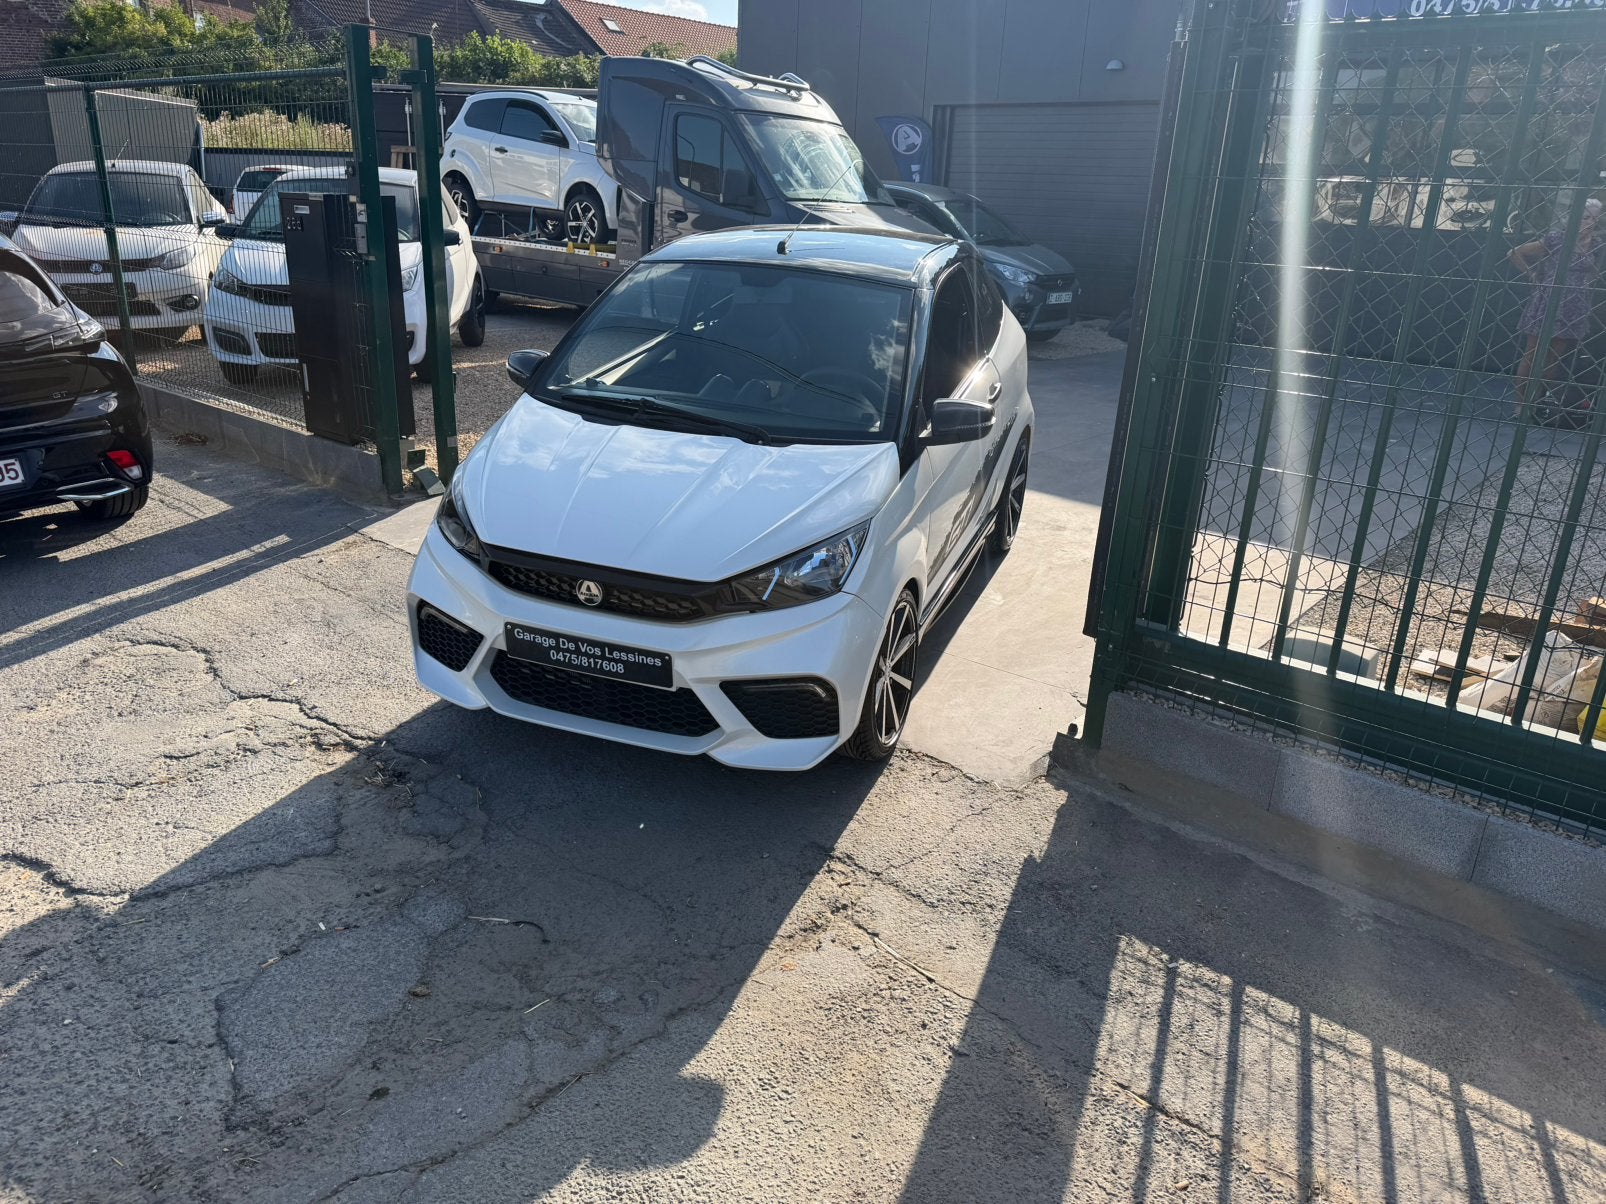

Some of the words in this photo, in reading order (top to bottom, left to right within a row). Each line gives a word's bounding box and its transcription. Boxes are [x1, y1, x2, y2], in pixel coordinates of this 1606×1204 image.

[514, 628, 556, 647] Garage
[559, 638, 576, 650] De
[579, 641, 601, 656] Vos
[605, 647, 662, 667] Lessines
[550, 650, 625, 674] 0475/817608
